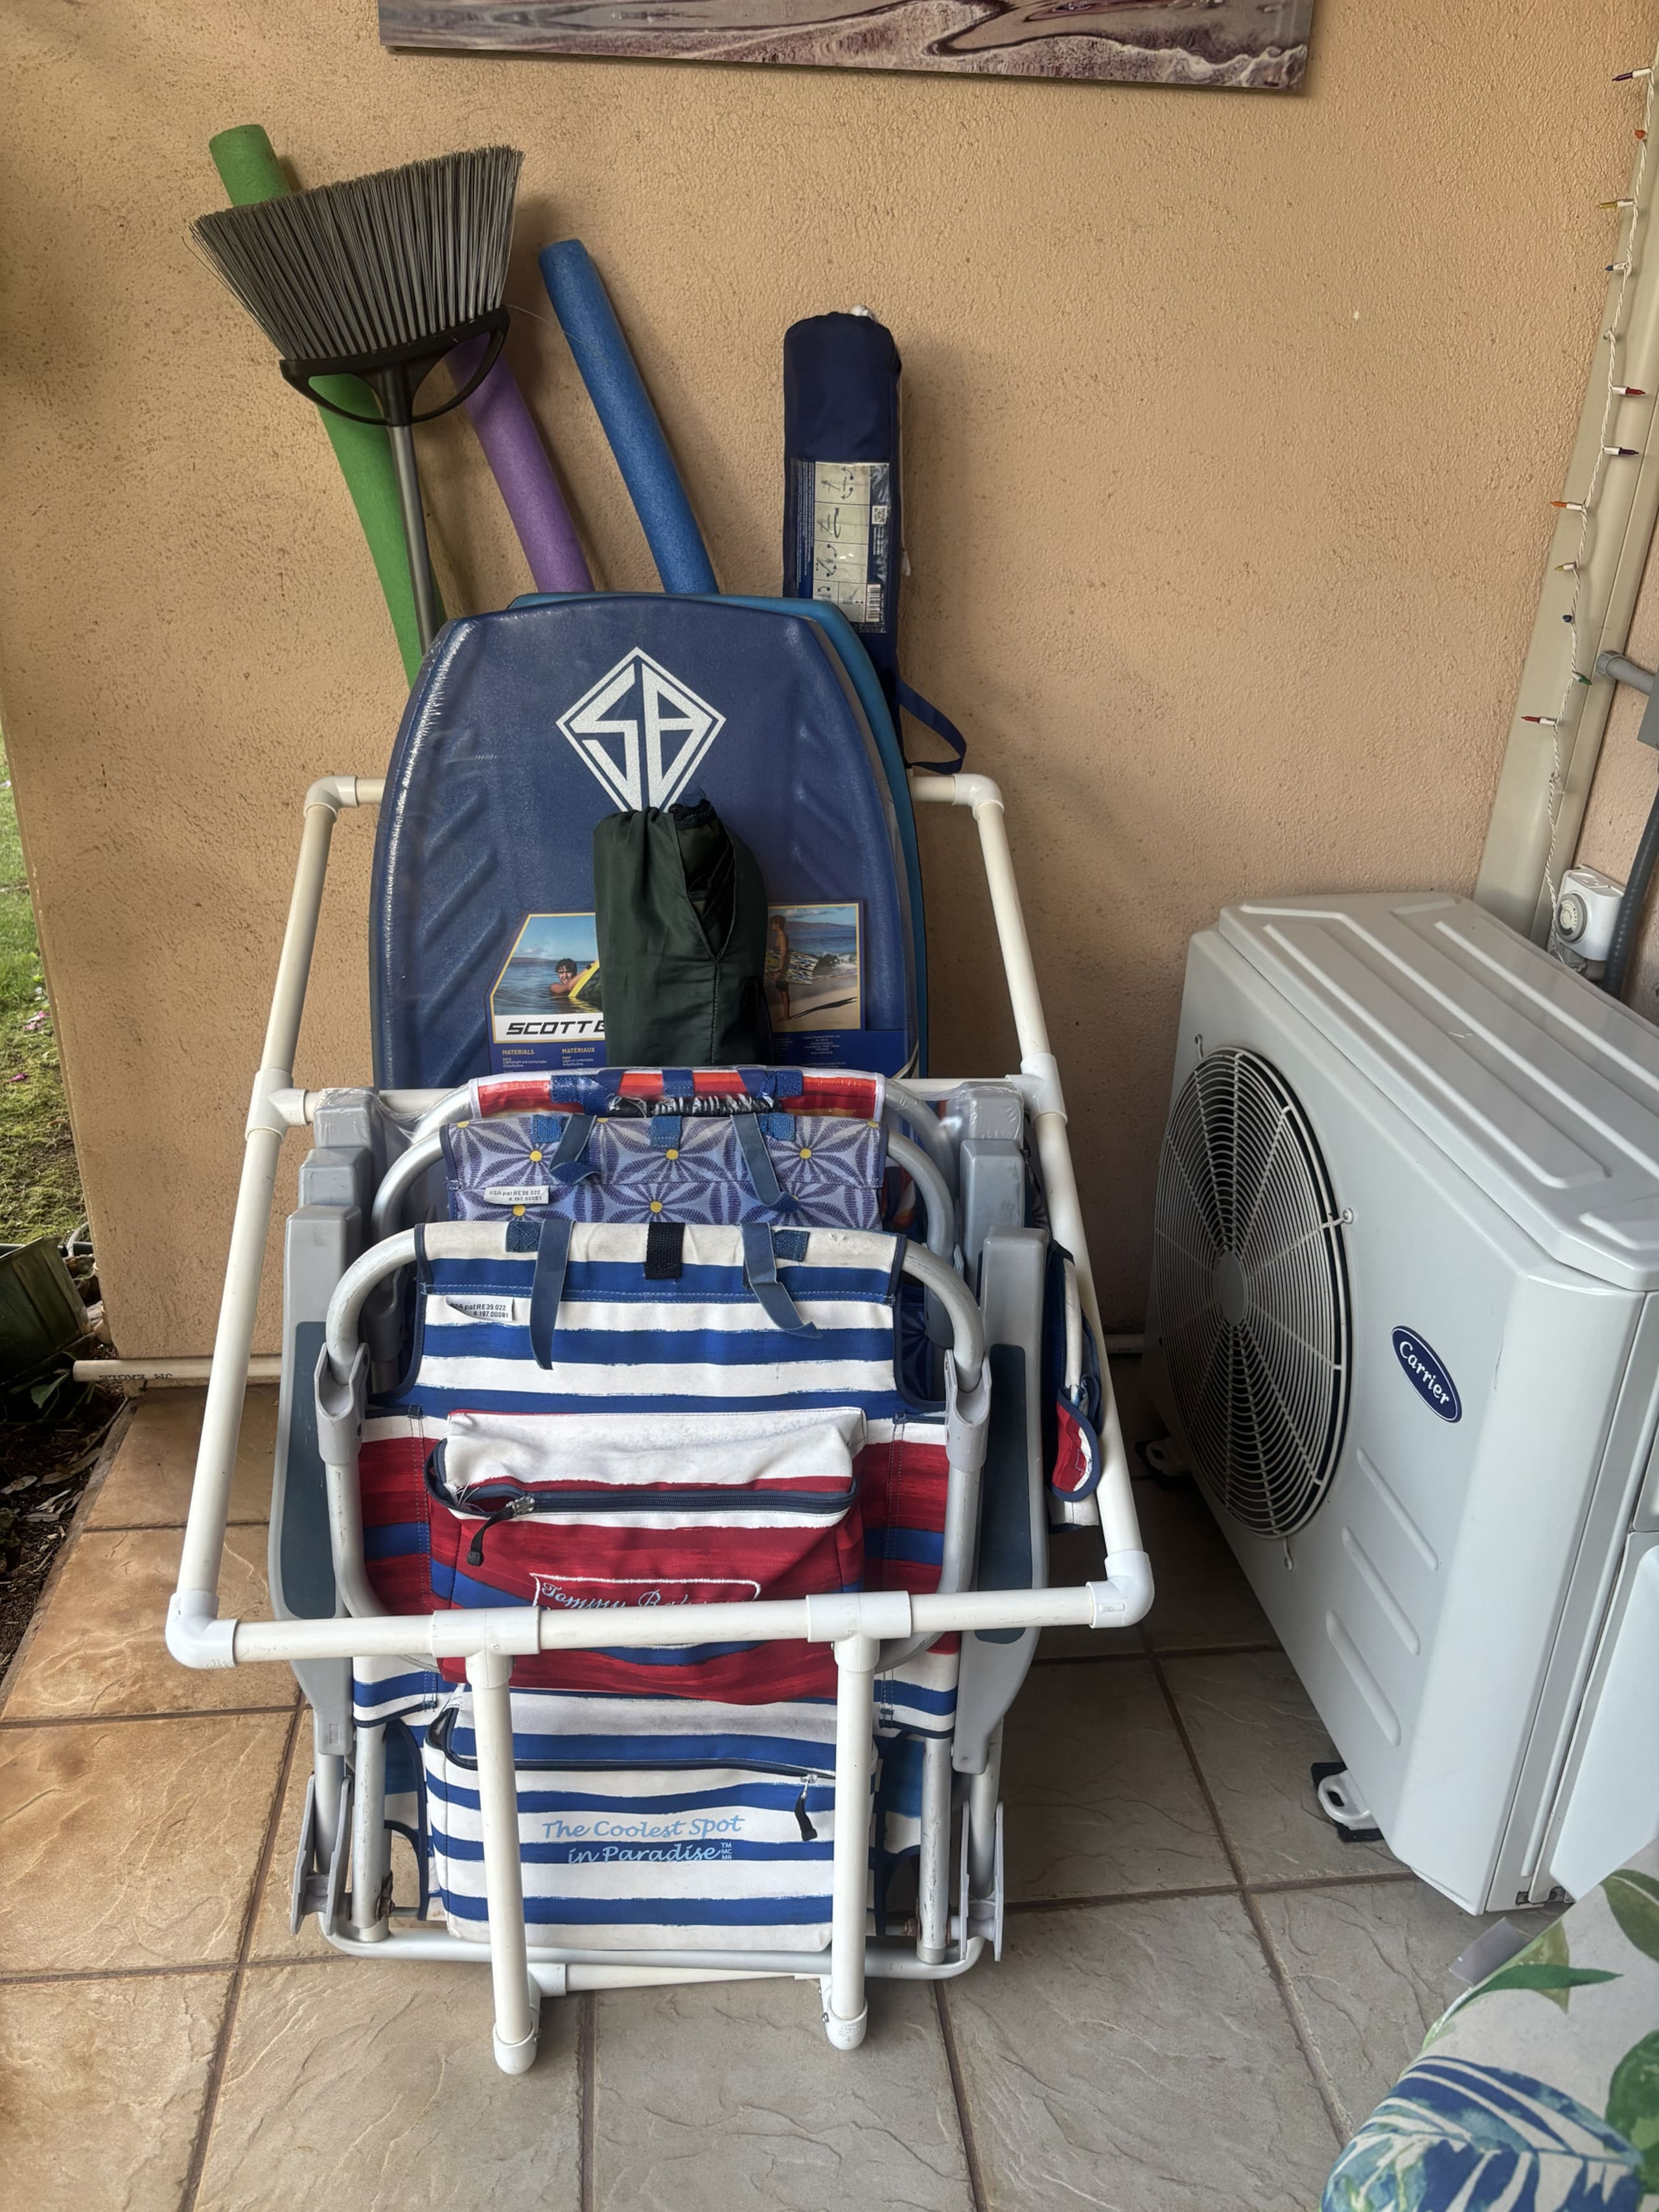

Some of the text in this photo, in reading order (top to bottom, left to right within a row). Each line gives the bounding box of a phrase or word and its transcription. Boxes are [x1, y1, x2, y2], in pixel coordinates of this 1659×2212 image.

[506, 1020, 593, 1035] SCOTT
[1399, 1340, 1450, 1405] Carrier
[542, 1815, 745, 1839] The Coolest Spot
[568, 1843, 721, 1864] in Paradise
